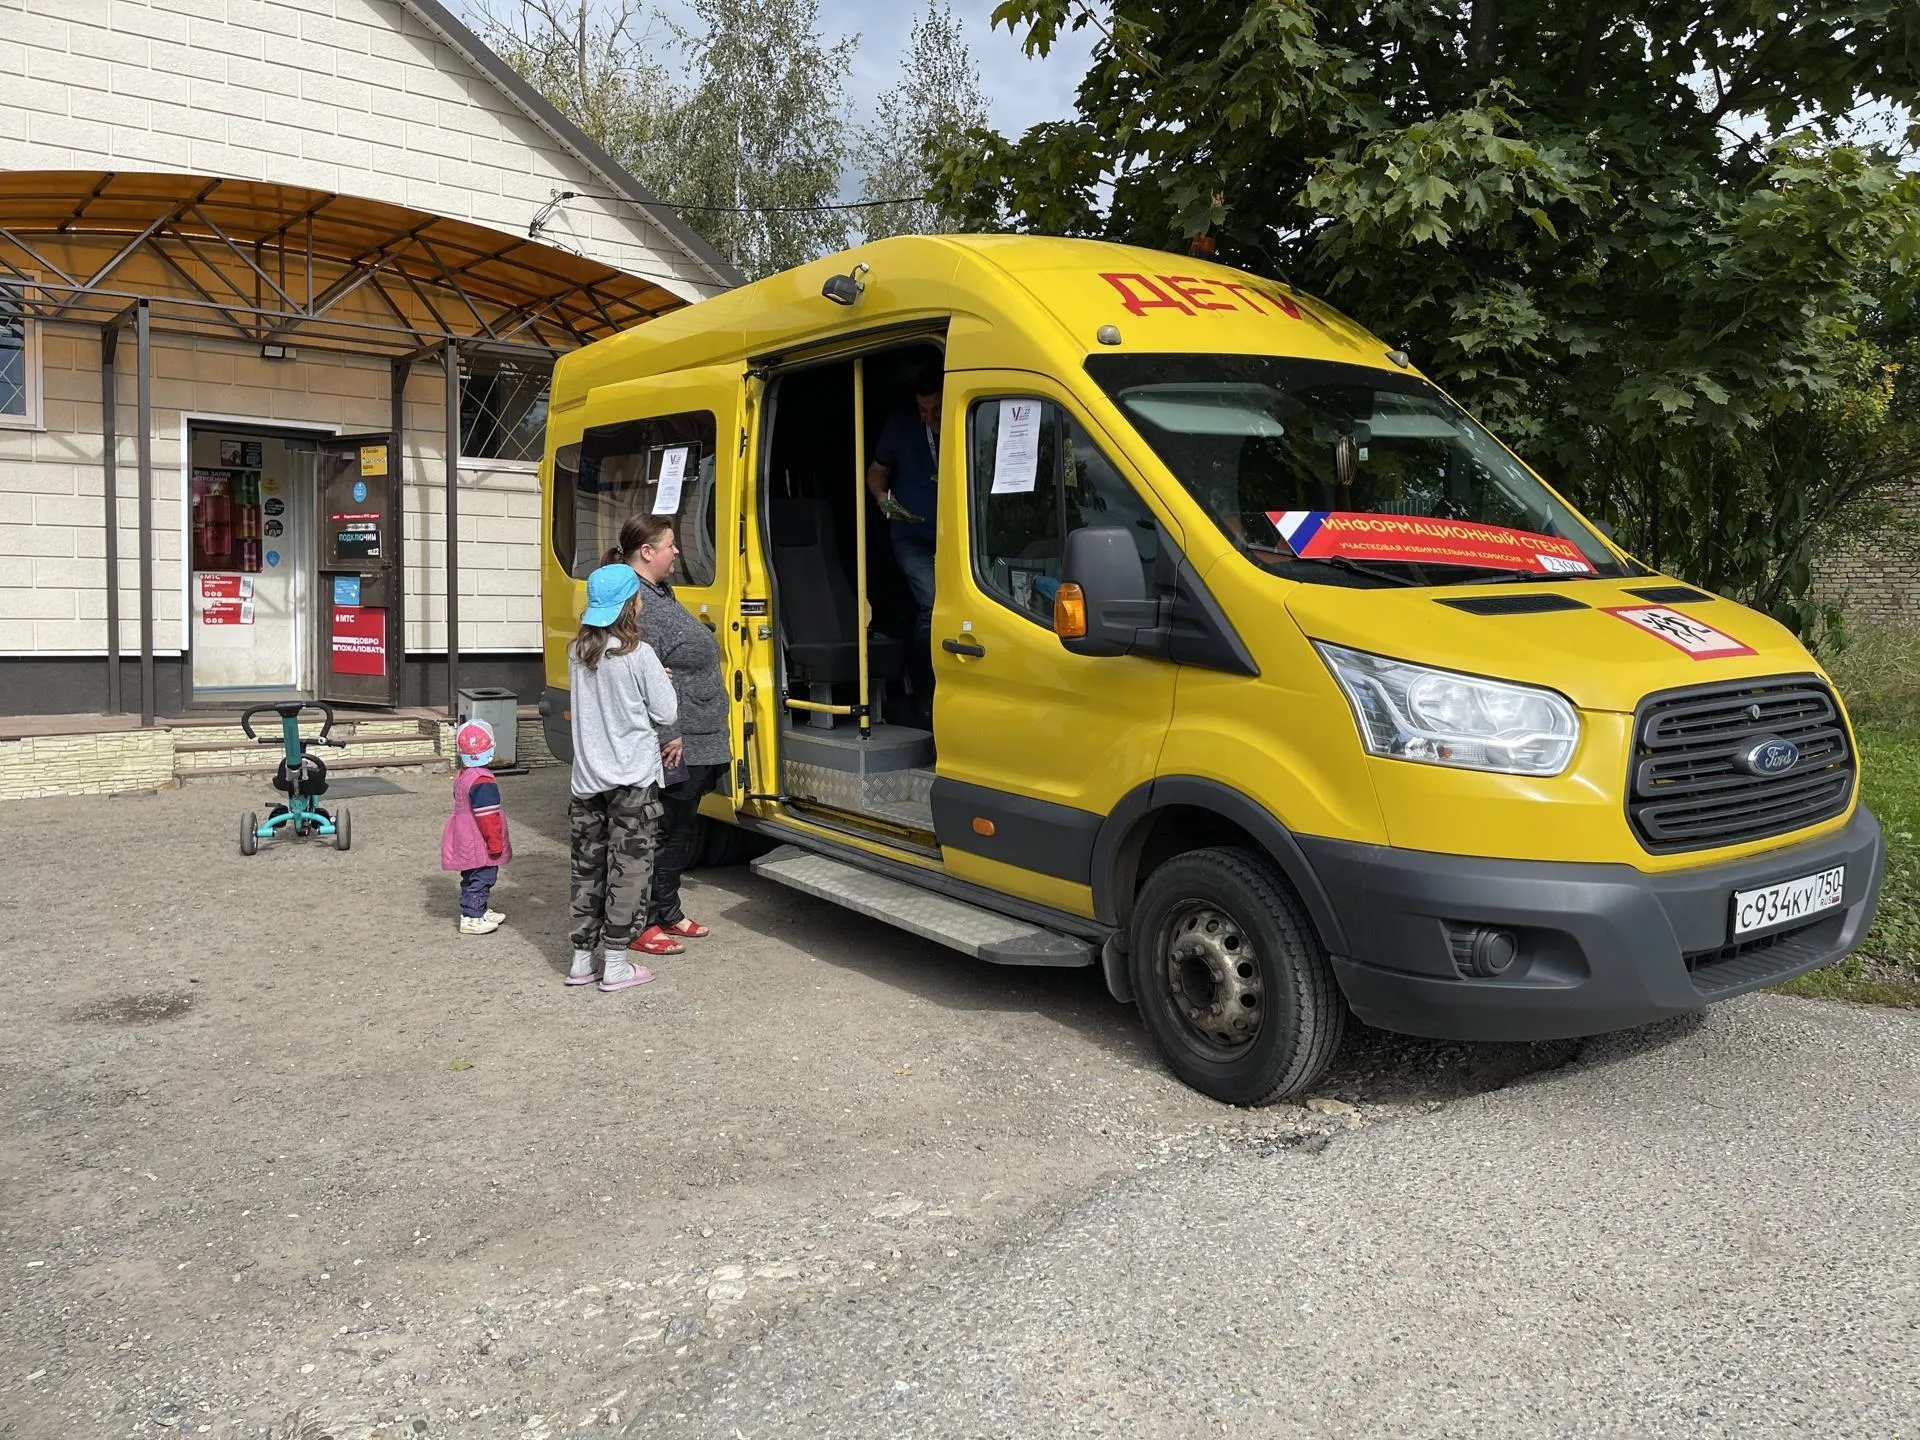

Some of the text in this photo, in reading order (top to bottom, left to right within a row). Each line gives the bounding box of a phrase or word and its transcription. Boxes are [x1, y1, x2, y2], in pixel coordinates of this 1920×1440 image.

[1098, 273, 1328, 326] ДЕТИ
[338, 533, 377, 543] ПОДКЛЮЧИМ
[1320, 518, 1578, 559] ИНФОРМАЦИОННЫЙ СТЕНД
[1339, 542, 1402, 552] УЧАСТКОВАЯ
[1403, 545, 1478, 558] ИЗБИРАТЕЛЬНАЯ
[1478, 552, 1523, 564] КОМИССИЯ
[340, 614, 355, 623] МТС
[336, 644, 384, 654] ПОЖАЛОВАТЬ
[353, 637, 379, 645] ДОБРО
[1765, 745, 1792, 769] Ford
[1741, 869, 1841, 929] С934КУ 750
[1820, 895, 1833, 906] RUS
